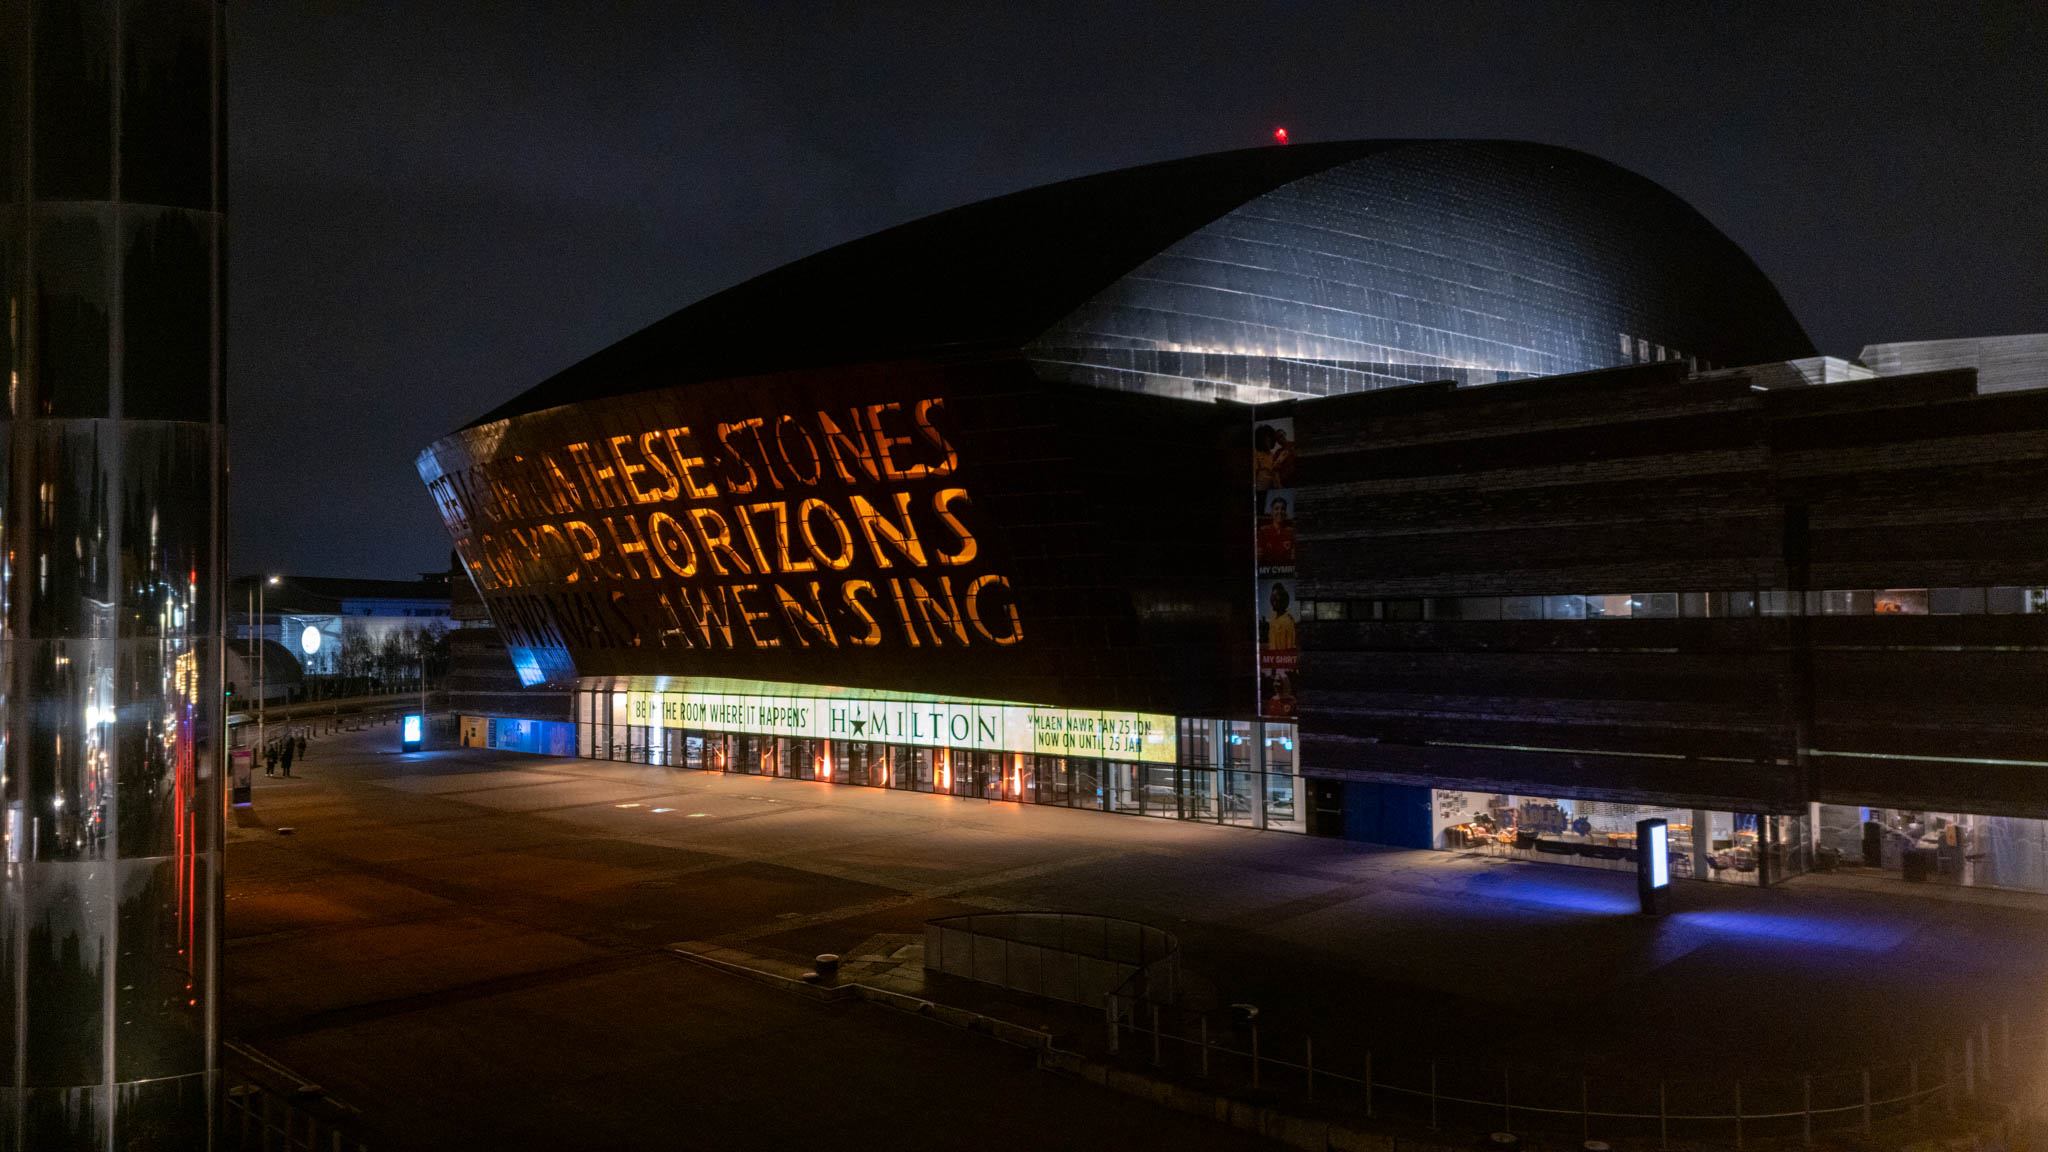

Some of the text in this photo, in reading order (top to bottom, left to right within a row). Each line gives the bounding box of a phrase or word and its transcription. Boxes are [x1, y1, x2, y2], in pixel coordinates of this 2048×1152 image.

[567, 426, 719, 510] THESE
[717, 397, 959, 495] STONES
[603, 488, 978, 581] HORIZONS
[657, 580, 838, 649] AWEN
[841, 575, 1025, 648] SING
[661, 702, 677, 720] THE
[680, 703, 706, 721] ROOM
[710, 704, 743, 725] WHERE
[747, 705, 755, 725] IT
[1067, 716, 1094, 732] NAWR
[1097, 718, 1115, 734] TAN
[1120, 719, 1130, 734] 25
[1039, 731, 1142, 753] NOW ON UNTIL 25 JAN
